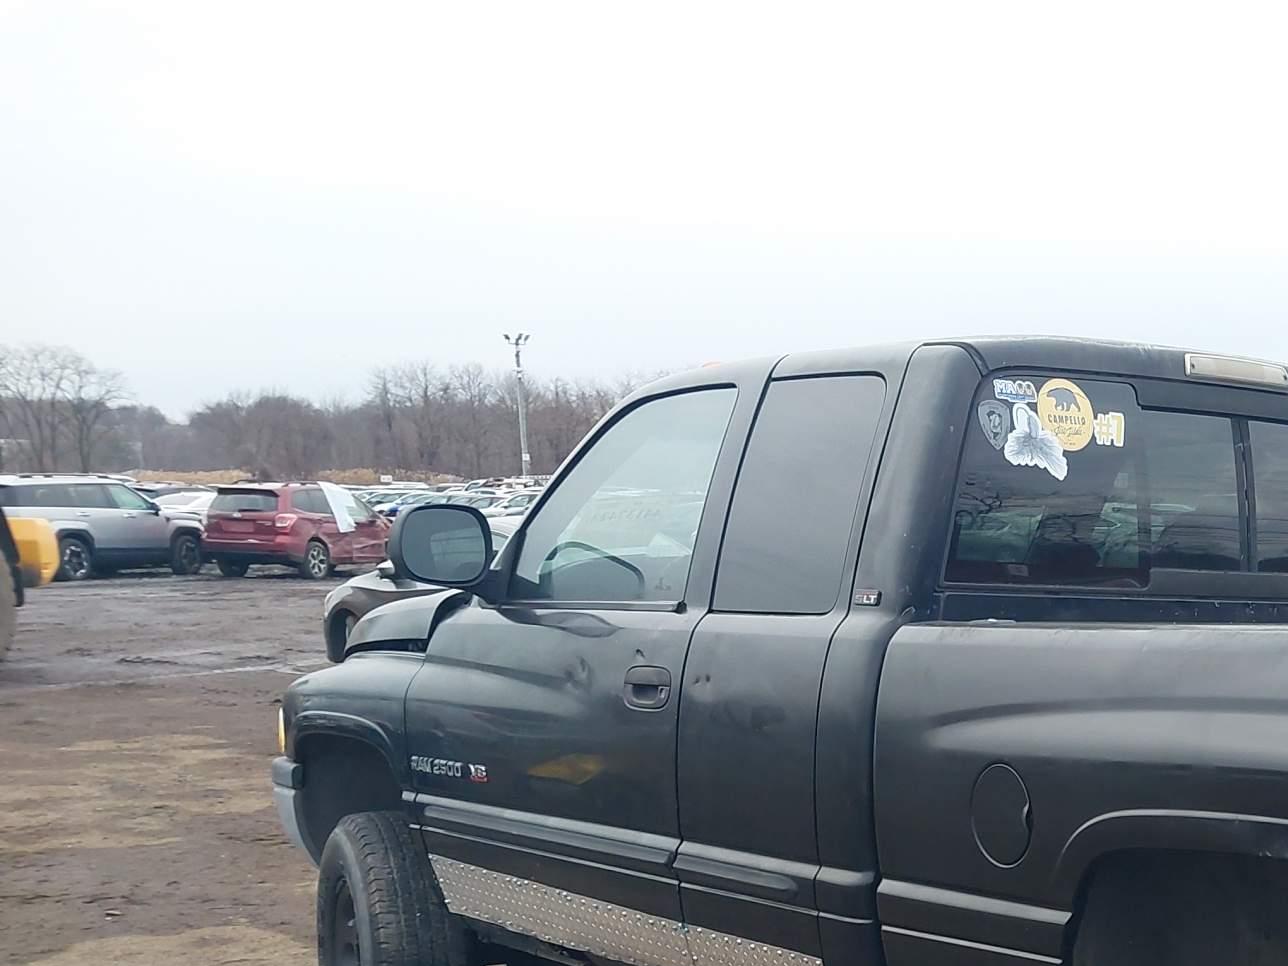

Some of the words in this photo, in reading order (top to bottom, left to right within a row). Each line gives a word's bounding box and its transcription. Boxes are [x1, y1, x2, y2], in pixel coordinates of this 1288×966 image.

[1048, 414, 1086, 425] CAMPELLO
[410, 755, 433, 773] RAM
[432, 758, 463, 777] 2500
